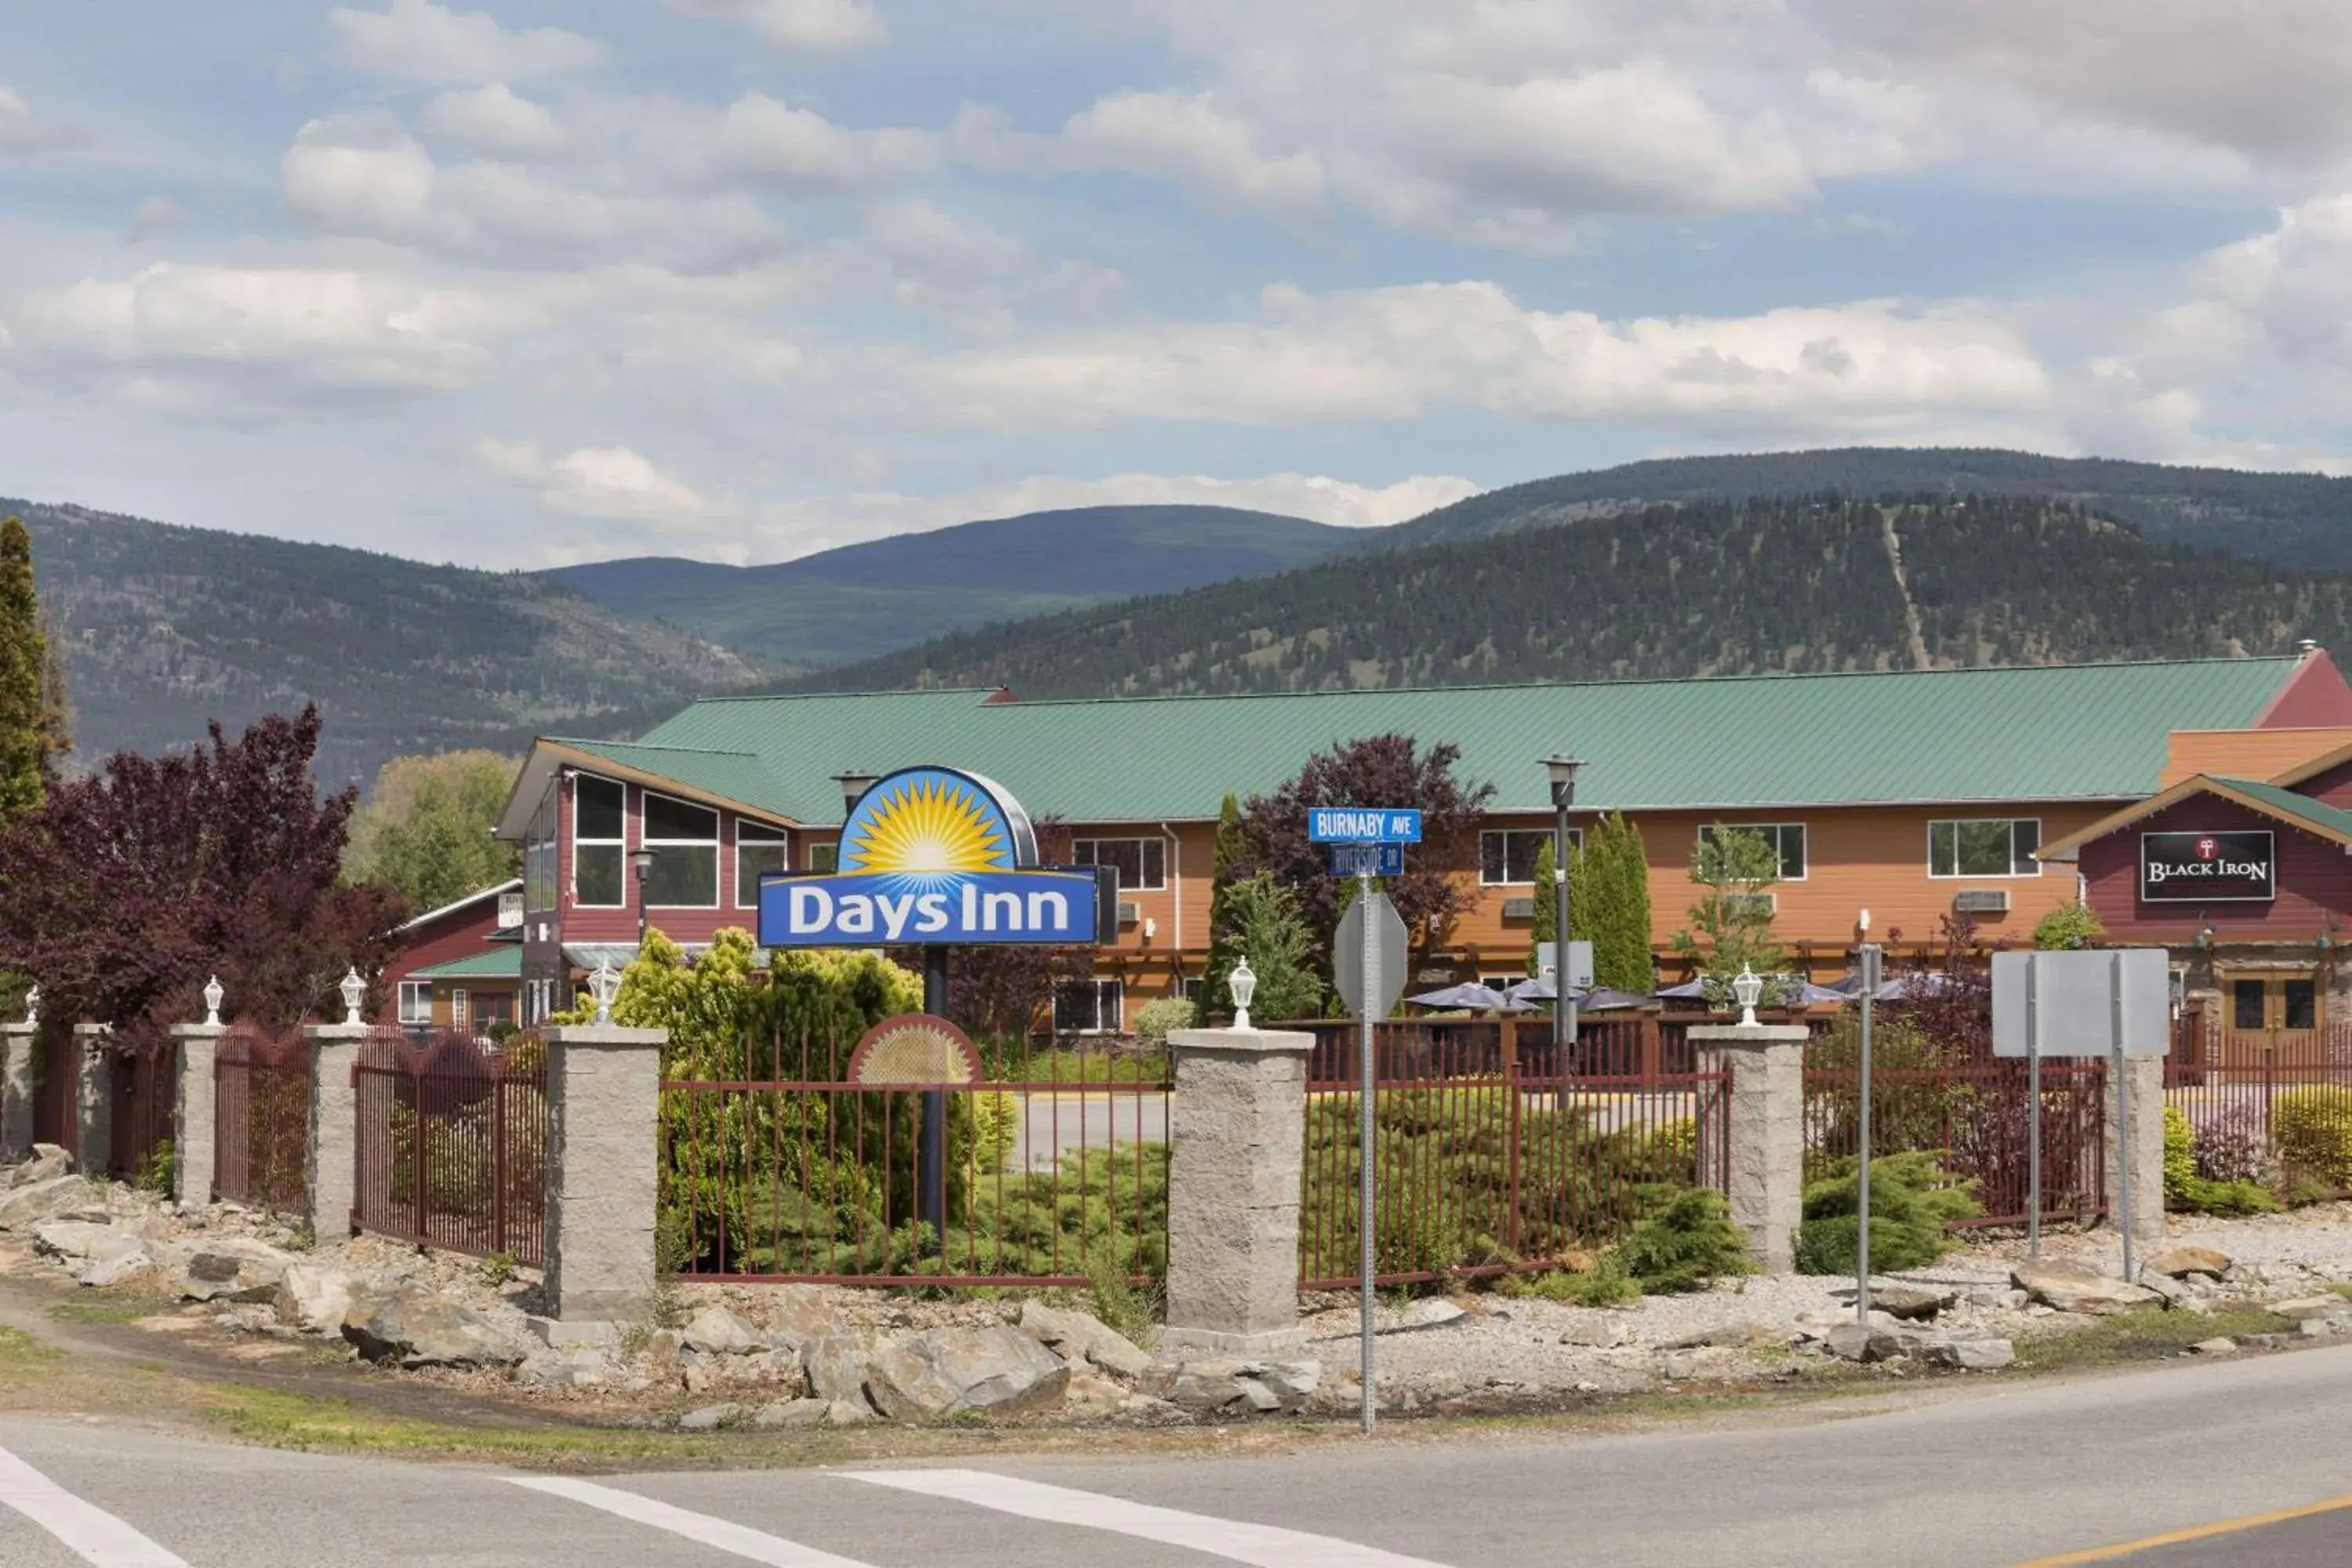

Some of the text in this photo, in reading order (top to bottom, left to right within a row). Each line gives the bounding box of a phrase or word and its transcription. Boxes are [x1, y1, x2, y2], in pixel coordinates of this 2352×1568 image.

[1317, 812, 1412, 837] BURNABY AVE
[1335, 847, 1384, 872] RIVERSIDE
[2147, 858, 2267, 883] BLACK IRON
[789, 884, 1069, 940] Days Inn
